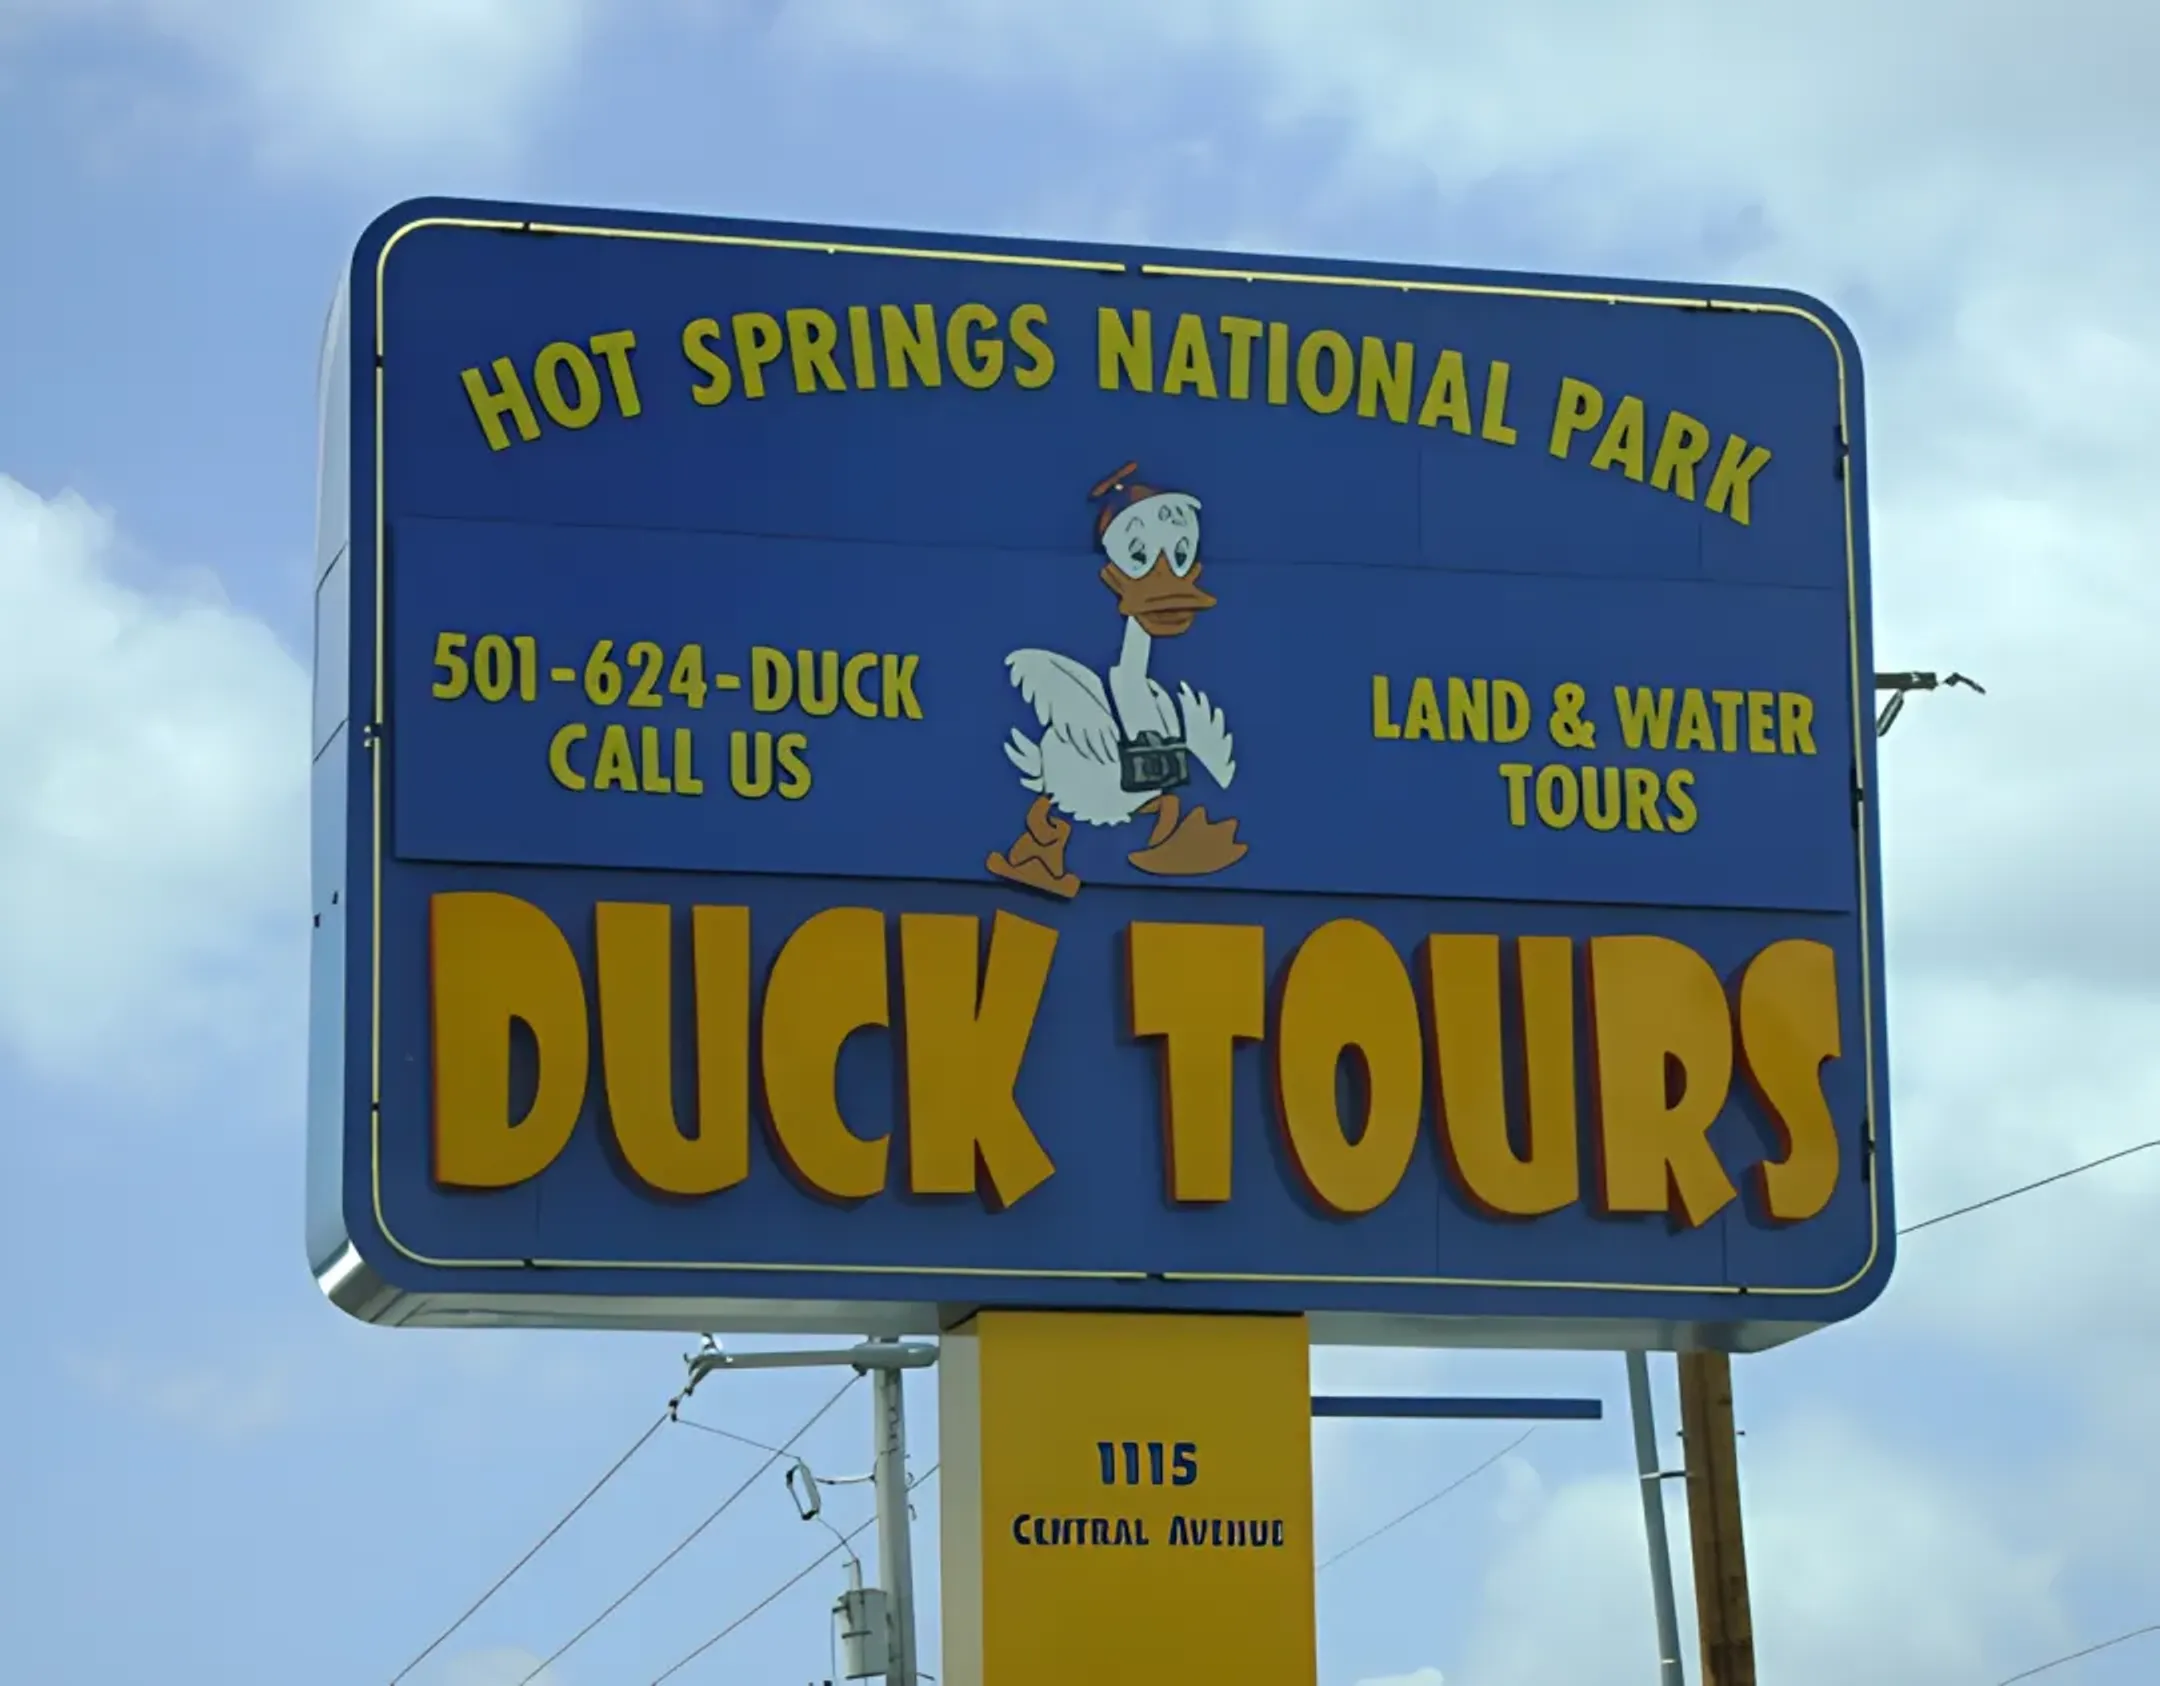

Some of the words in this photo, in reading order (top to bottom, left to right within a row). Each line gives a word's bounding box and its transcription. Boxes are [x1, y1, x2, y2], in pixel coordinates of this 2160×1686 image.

[462, 330, 641, 451] HOT
[682, 303, 1055, 405] SPRINGS
[1099, 307, 1517, 445] NATIONAL
[1549, 378, 1772, 526] PARK
[432, 632, 923, 720] 501-624-DUCK
[1373, 675, 1531, 743] LAND
[1549, 682, 1596, 749] &
[1614, 685, 1816, 755] WATER
[549, 723, 704, 794] CALL
[731, 730, 811, 799] US
[1499, 763, 1698, 833] TOURS
[430, 891, 1059, 1208] DUCK
[1129, 920, 1842, 1228] TOURS
[1097, 1441, 1198, 1486] 1115
